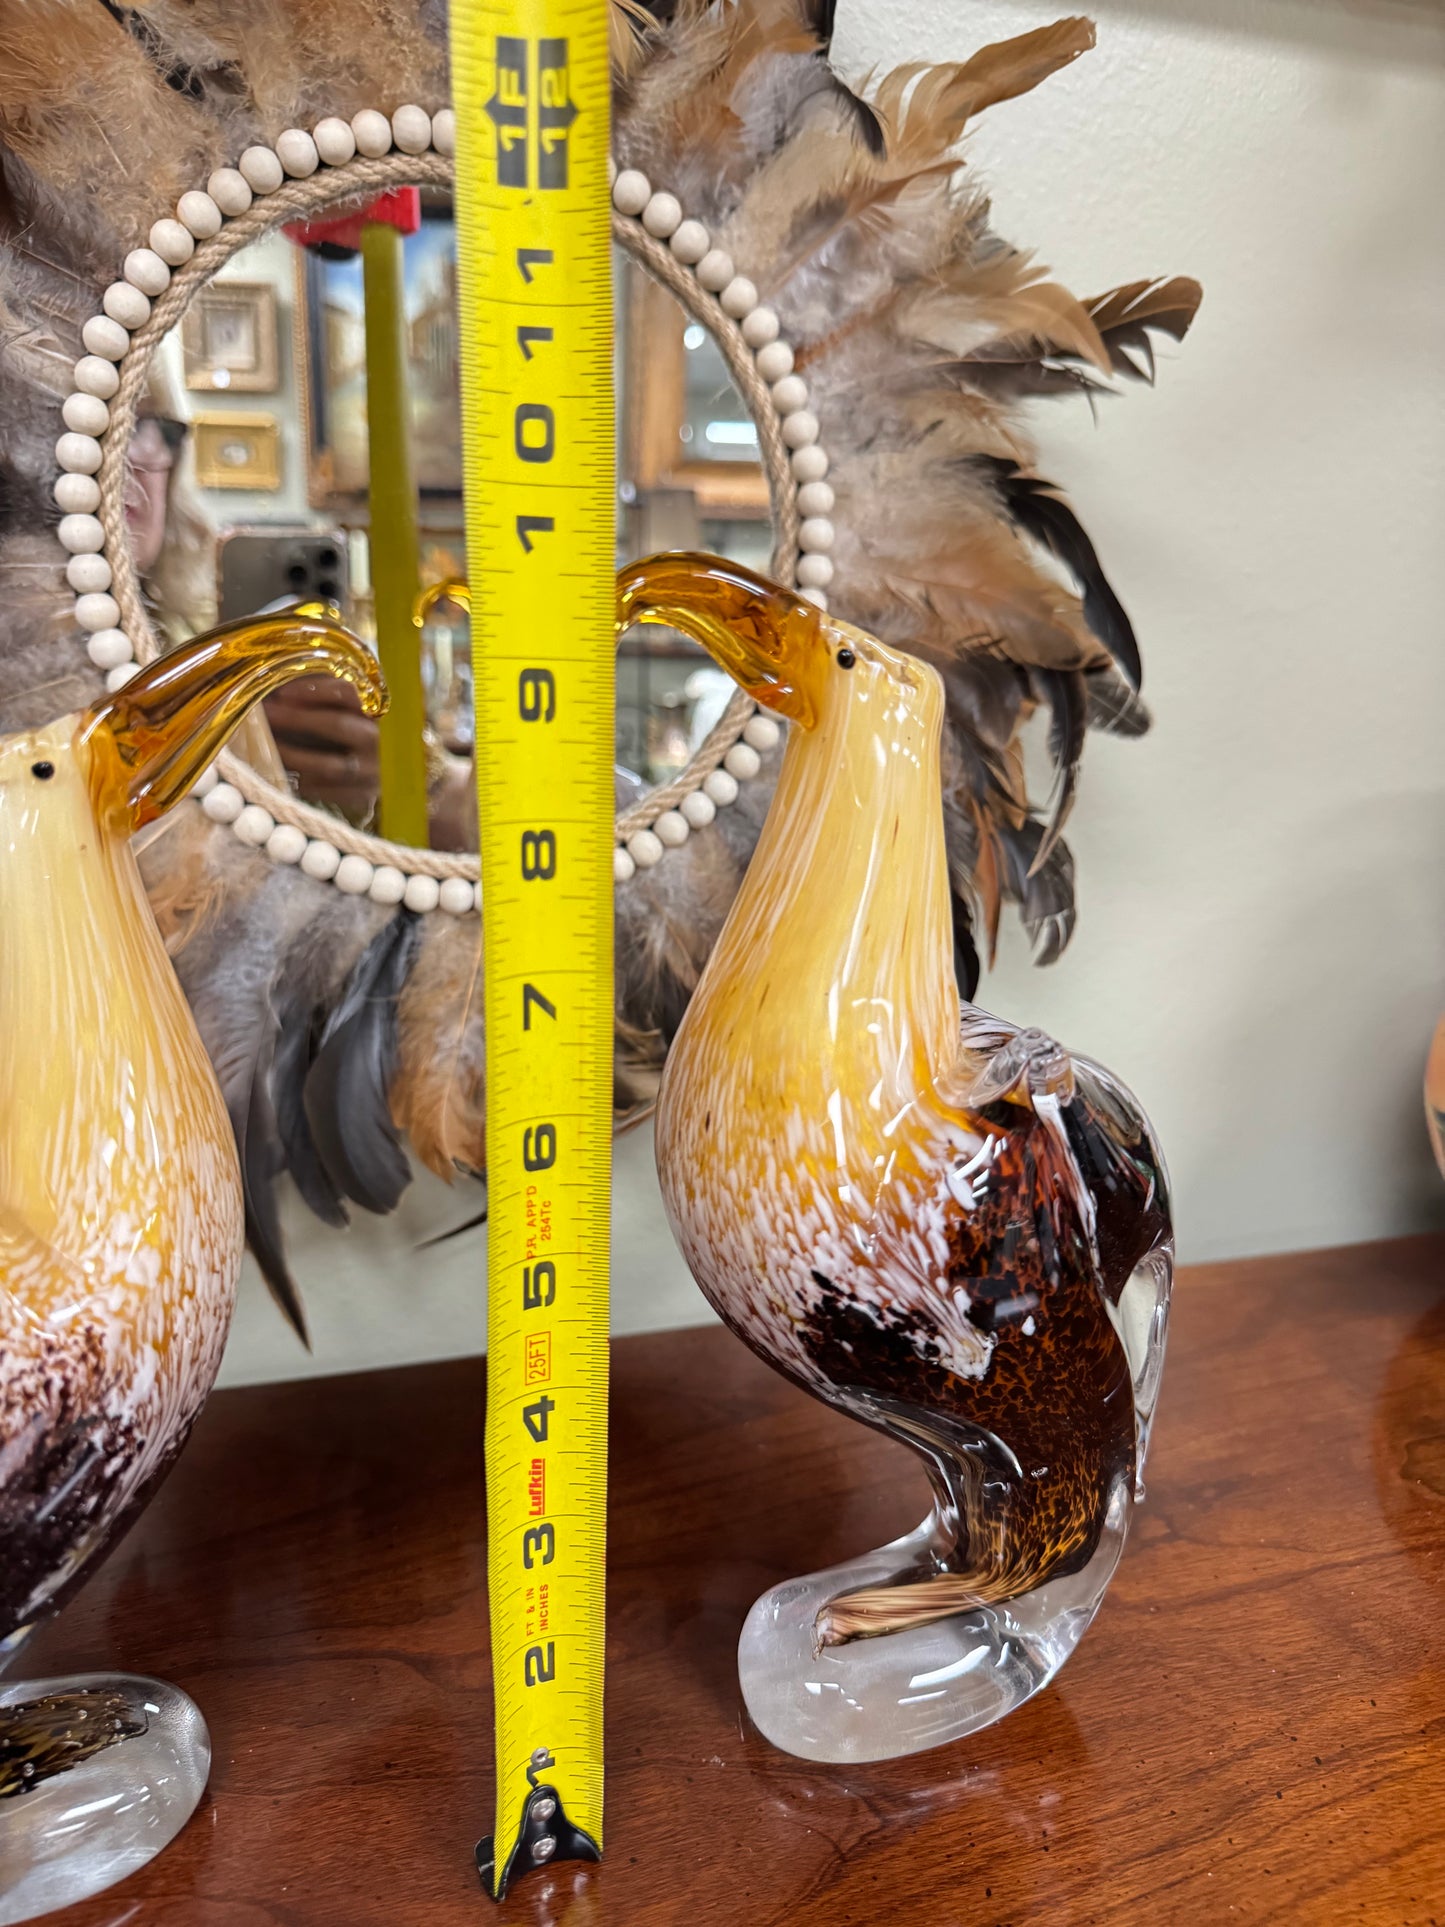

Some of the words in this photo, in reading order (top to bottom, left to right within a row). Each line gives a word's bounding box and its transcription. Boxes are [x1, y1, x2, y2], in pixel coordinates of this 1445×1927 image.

[541, 68, 567, 154] 12
[516, 247, 553, 361] 11
[514, 403, 554, 554] 10
[519, 668, 556, 724] 9
[521, 829, 556, 881] 8
[523, 983, 557, 1031] 7
[523, 1123, 557, 1172] 6
[523, 1261, 556, 1311] 5
[529, 1338, 547, 1379] 25FT
[523, 1395, 555, 1443] 4
[528, 1458, 545, 1516] Lufkin
[523, 1522, 555, 1570] 3
[525, 1587, 534, 1601] IN
[525, 1605, 535, 1614] &
[539, 1584, 549, 1631] INCHES
[526, 1622, 535, 1637] FT
[524, 1641, 555, 1687] 2
